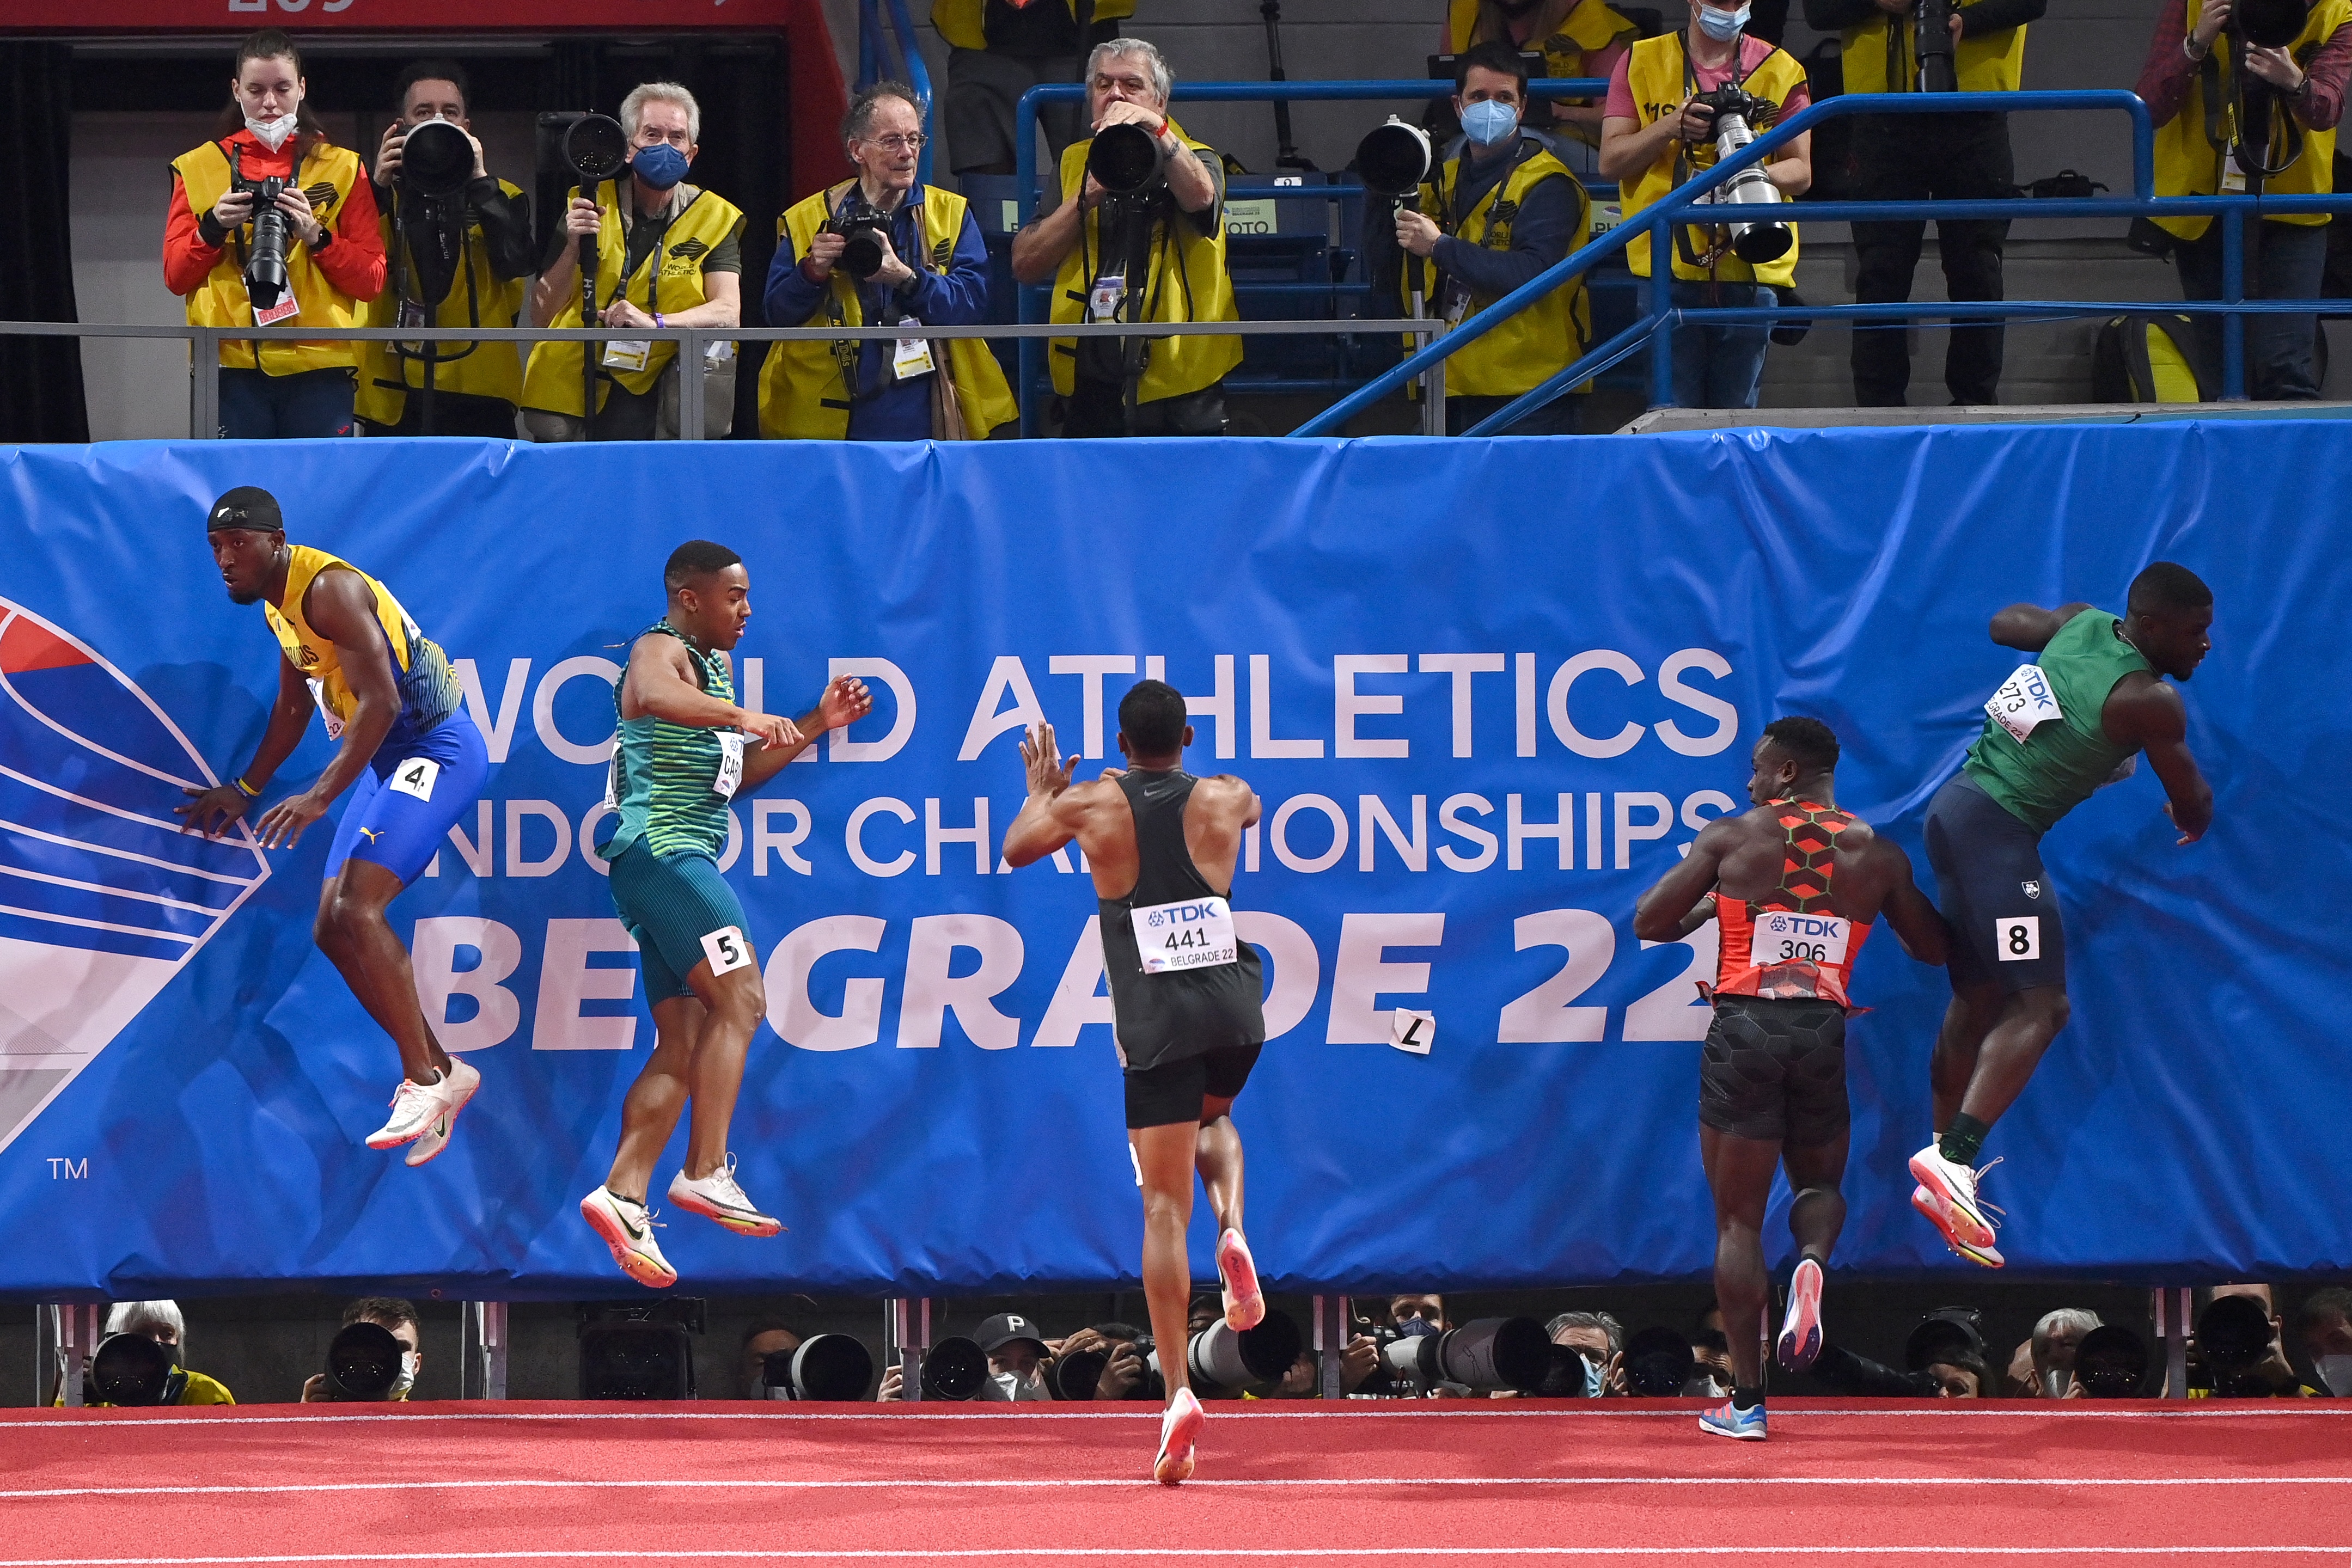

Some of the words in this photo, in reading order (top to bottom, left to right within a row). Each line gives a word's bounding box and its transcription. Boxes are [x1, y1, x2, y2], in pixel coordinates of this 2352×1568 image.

[1224, 220, 1268, 234] OTO
[1999, 682, 2026, 713] 273
[2025, 671, 2054, 710] TDK
[957, 648, 1739, 761] ATHLETICS
[2011, 726, 2024, 739] 22
[405, 765, 425, 792] 4
[845, 789, 1737, 877] CHIONSHIPS
[1163, 902, 1218, 924] TDK
[1165, 927, 1211, 951] 441
[1787, 917, 1840, 939] TDK
[2009, 924, 2030, 955] 8
[717, 935, 739, 965] 5
[1171, 950, 1220, 967] BELGRADE
[1221, 948, 1234, 960] 22
[1779, 940, 1826, 961] 306
[411, 910, 1445, 1052] BEGRADE
[1497, 908, 1719, 1043] 22
[46, 1157, 87, 1180] TM
[1007, 1315, 1025, 1332] P
